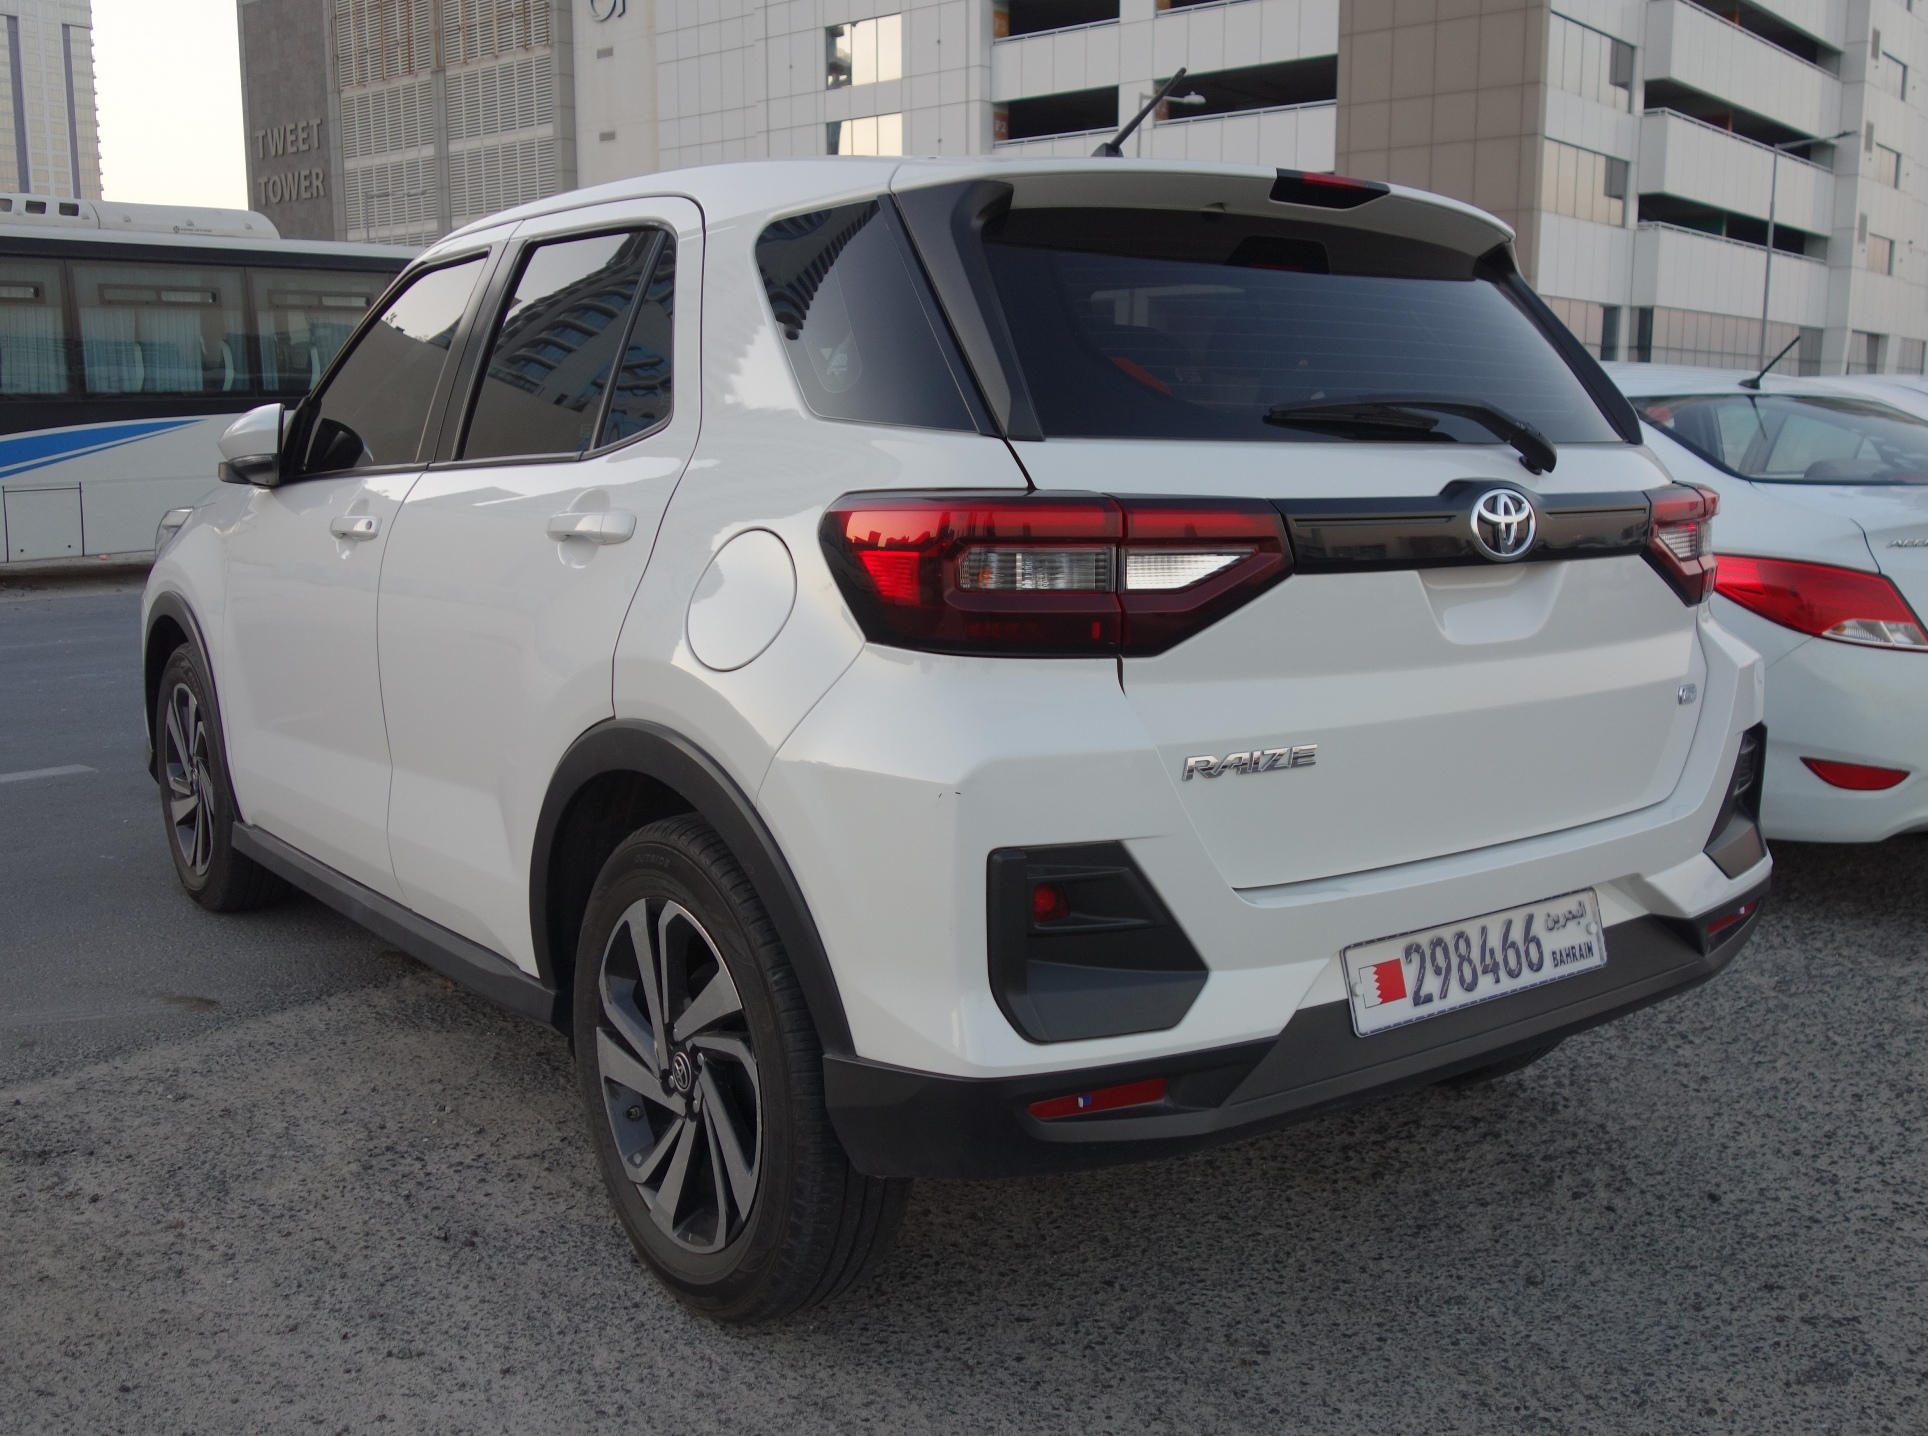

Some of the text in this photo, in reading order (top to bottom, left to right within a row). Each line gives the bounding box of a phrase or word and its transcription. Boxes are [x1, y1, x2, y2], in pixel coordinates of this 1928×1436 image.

[255, 117, 322, 160] TWEET
[257, 167, 325, 206] TOWER
[1182, 743, 1318, 781] RAIZE
[1545, 899, 1586, 931] البحرين
[1404, 912, 1544, 1007] 298466
